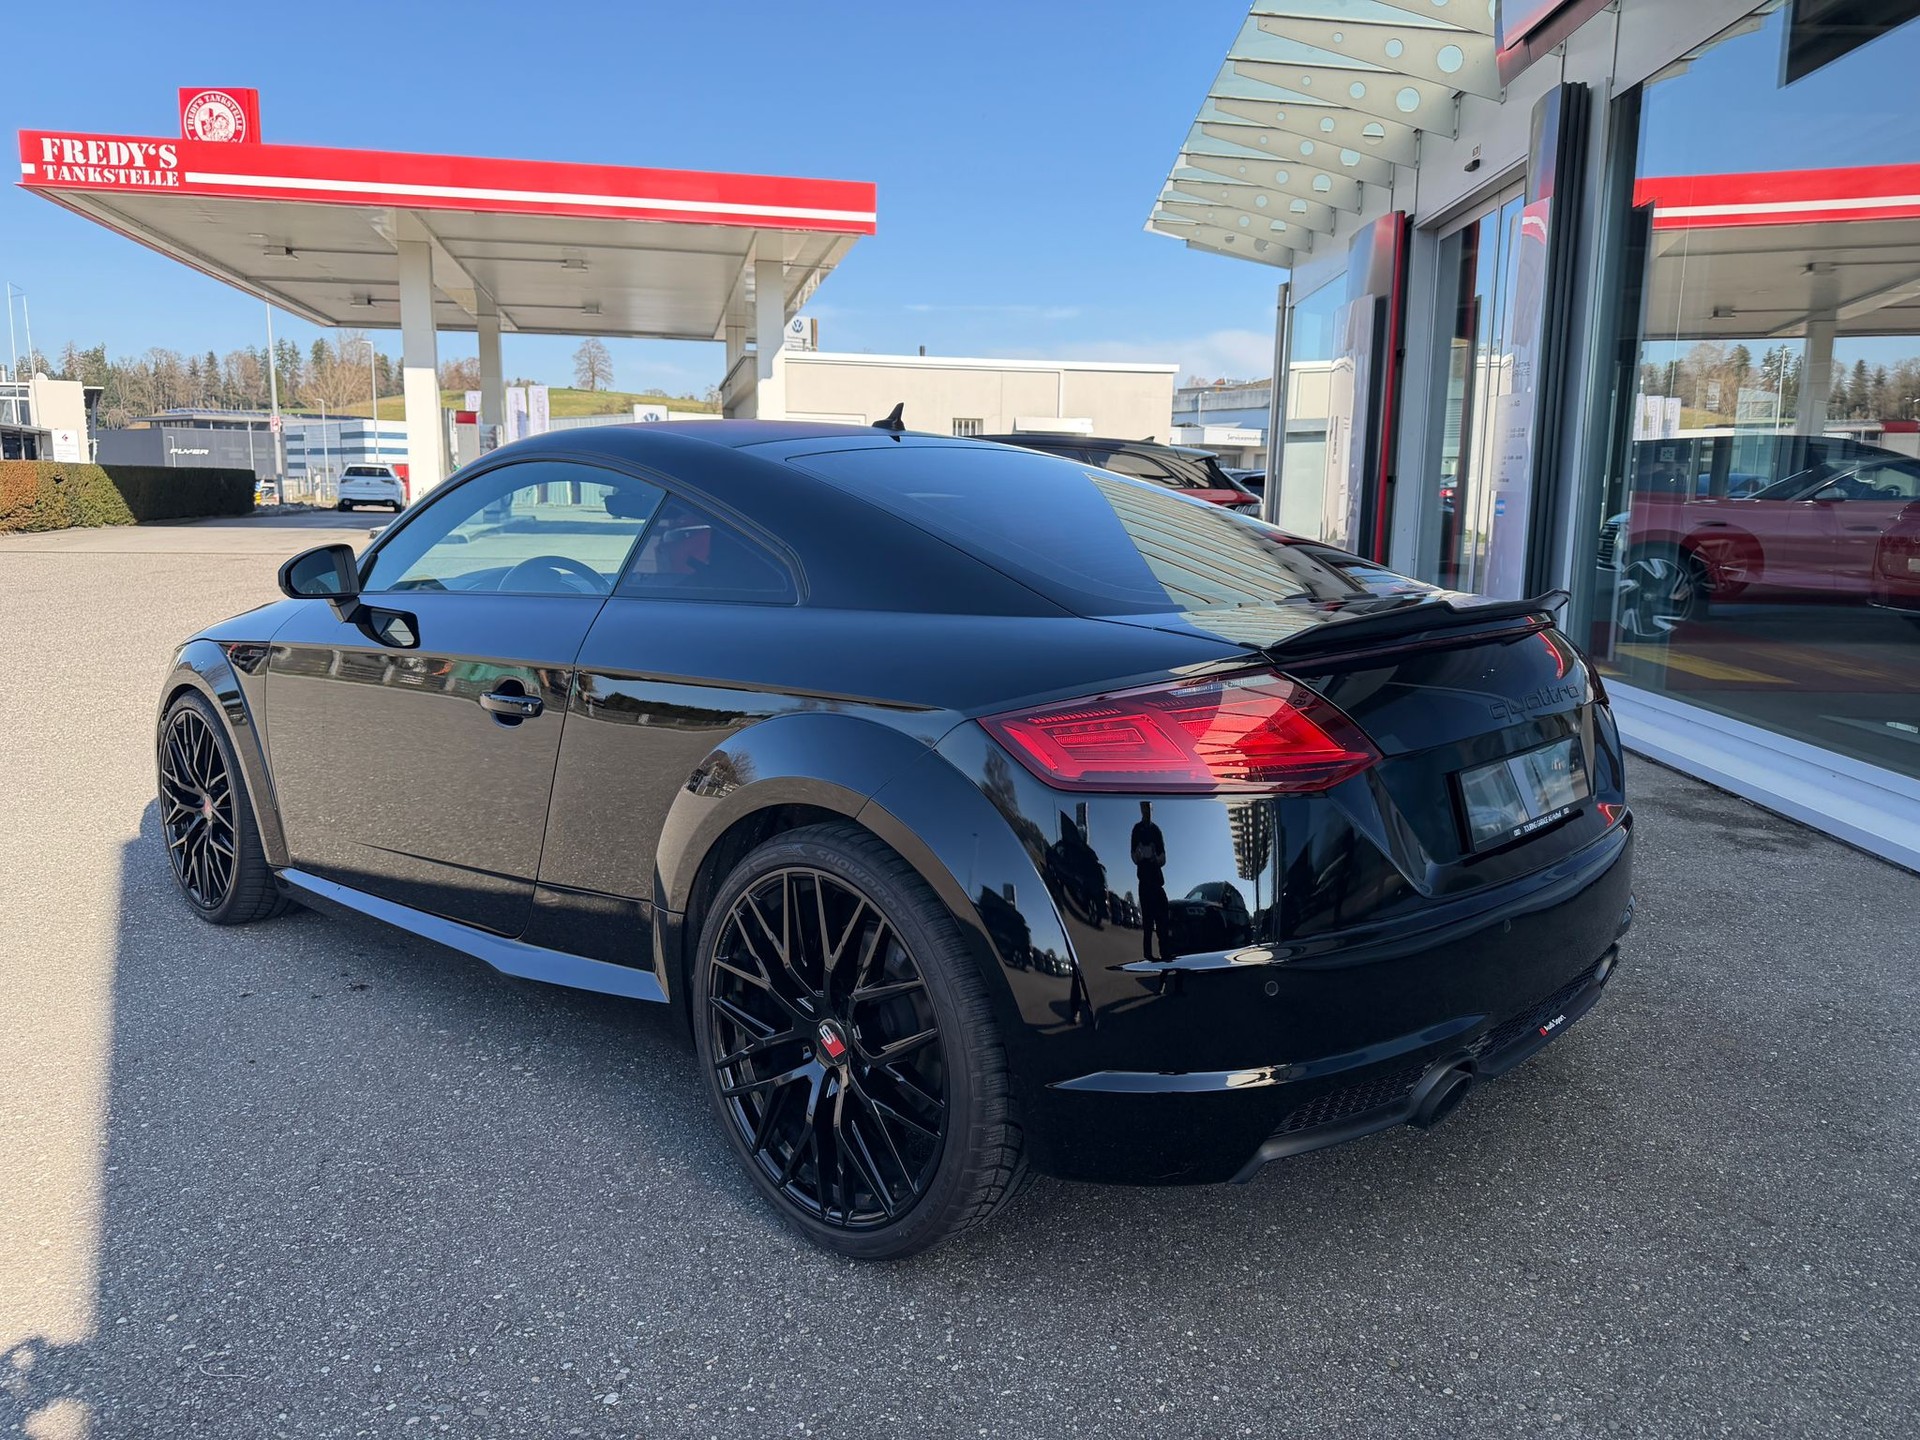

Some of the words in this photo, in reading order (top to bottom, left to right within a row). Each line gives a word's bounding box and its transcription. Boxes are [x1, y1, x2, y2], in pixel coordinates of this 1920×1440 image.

[40, 137, 178, 168] FREDY'S
[43, 164, 179, 187] TANKSTELLE
[1490, 685, 1580, 723] quattro
[816, 849, 910, 921] SNOWPROX
